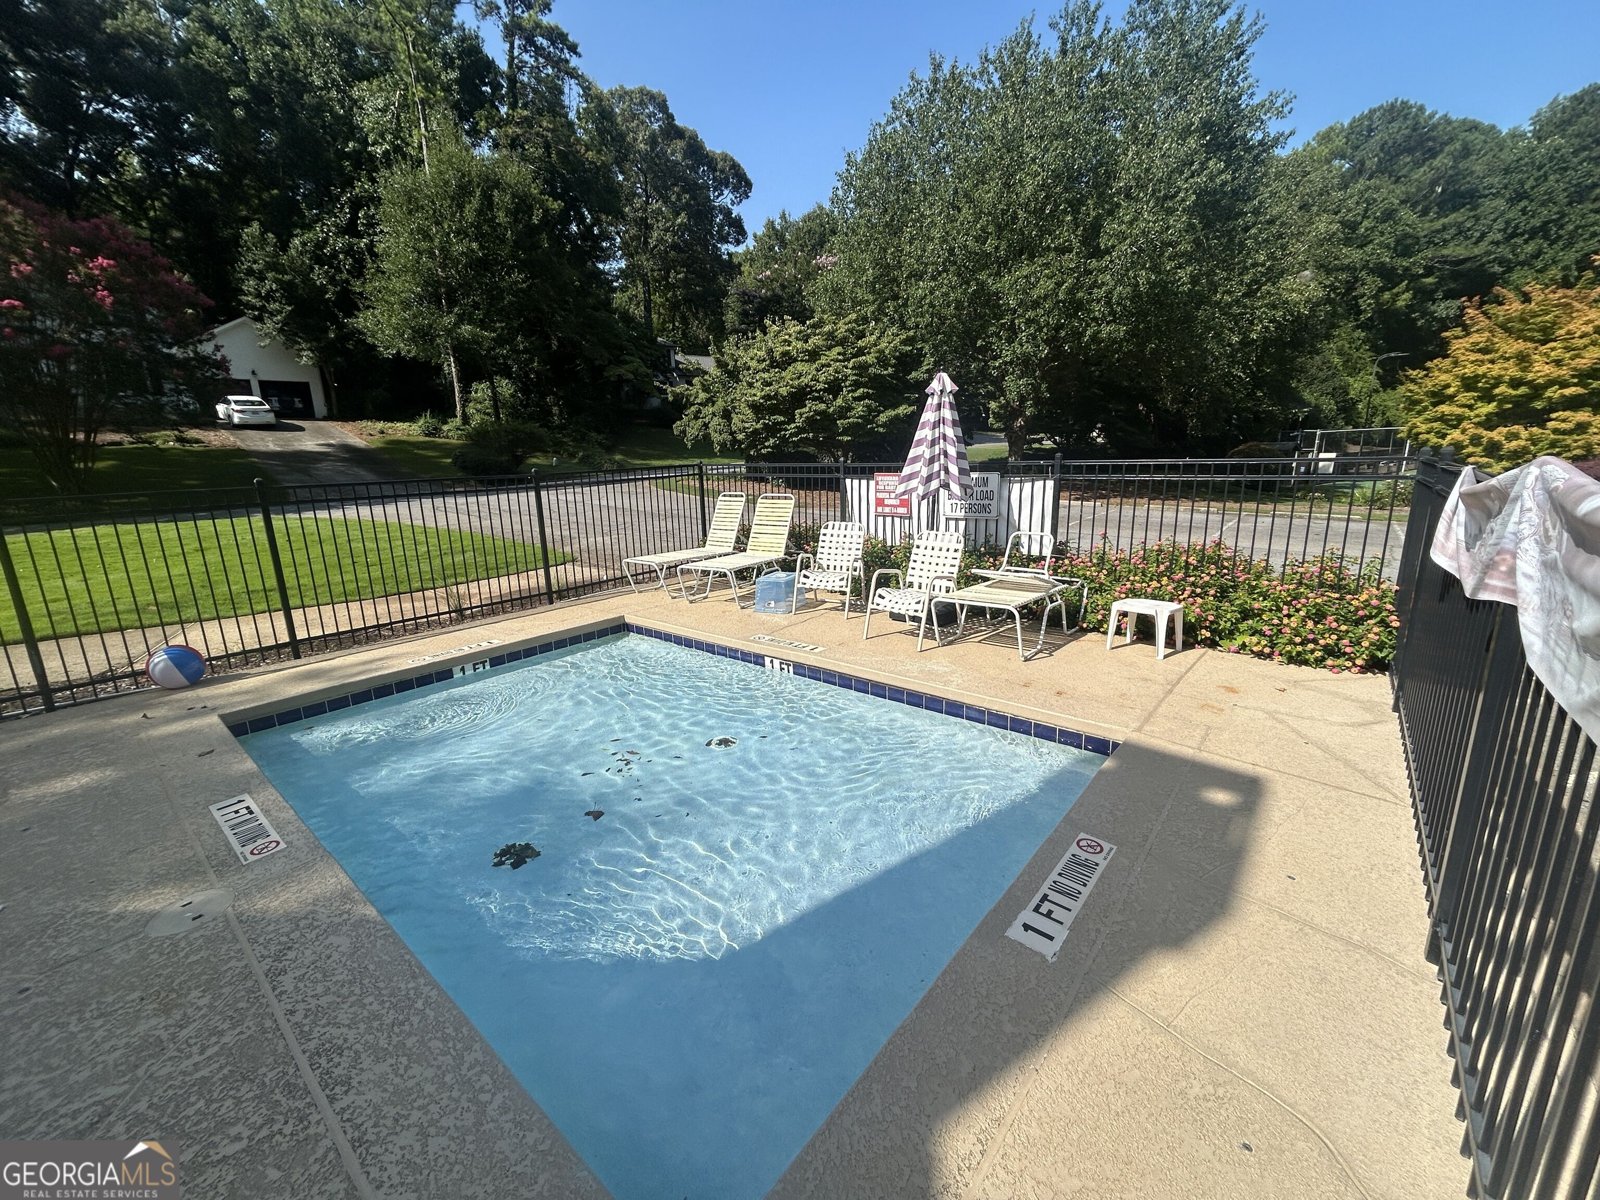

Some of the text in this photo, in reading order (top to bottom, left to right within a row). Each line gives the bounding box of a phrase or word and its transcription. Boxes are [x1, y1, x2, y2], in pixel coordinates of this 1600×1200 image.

[976, 490, 994, 501] LOAD
[951, 503, 992, 514] 17 PERSONS
[460, 660, 487, 675] 1 FT
[779, 661, 791, 673] FT
[217, 800, 245, 811] 1
[221, 805, 254, 822] FT
[1022, 853, 1100, 941] 1 FT NO DIVING
